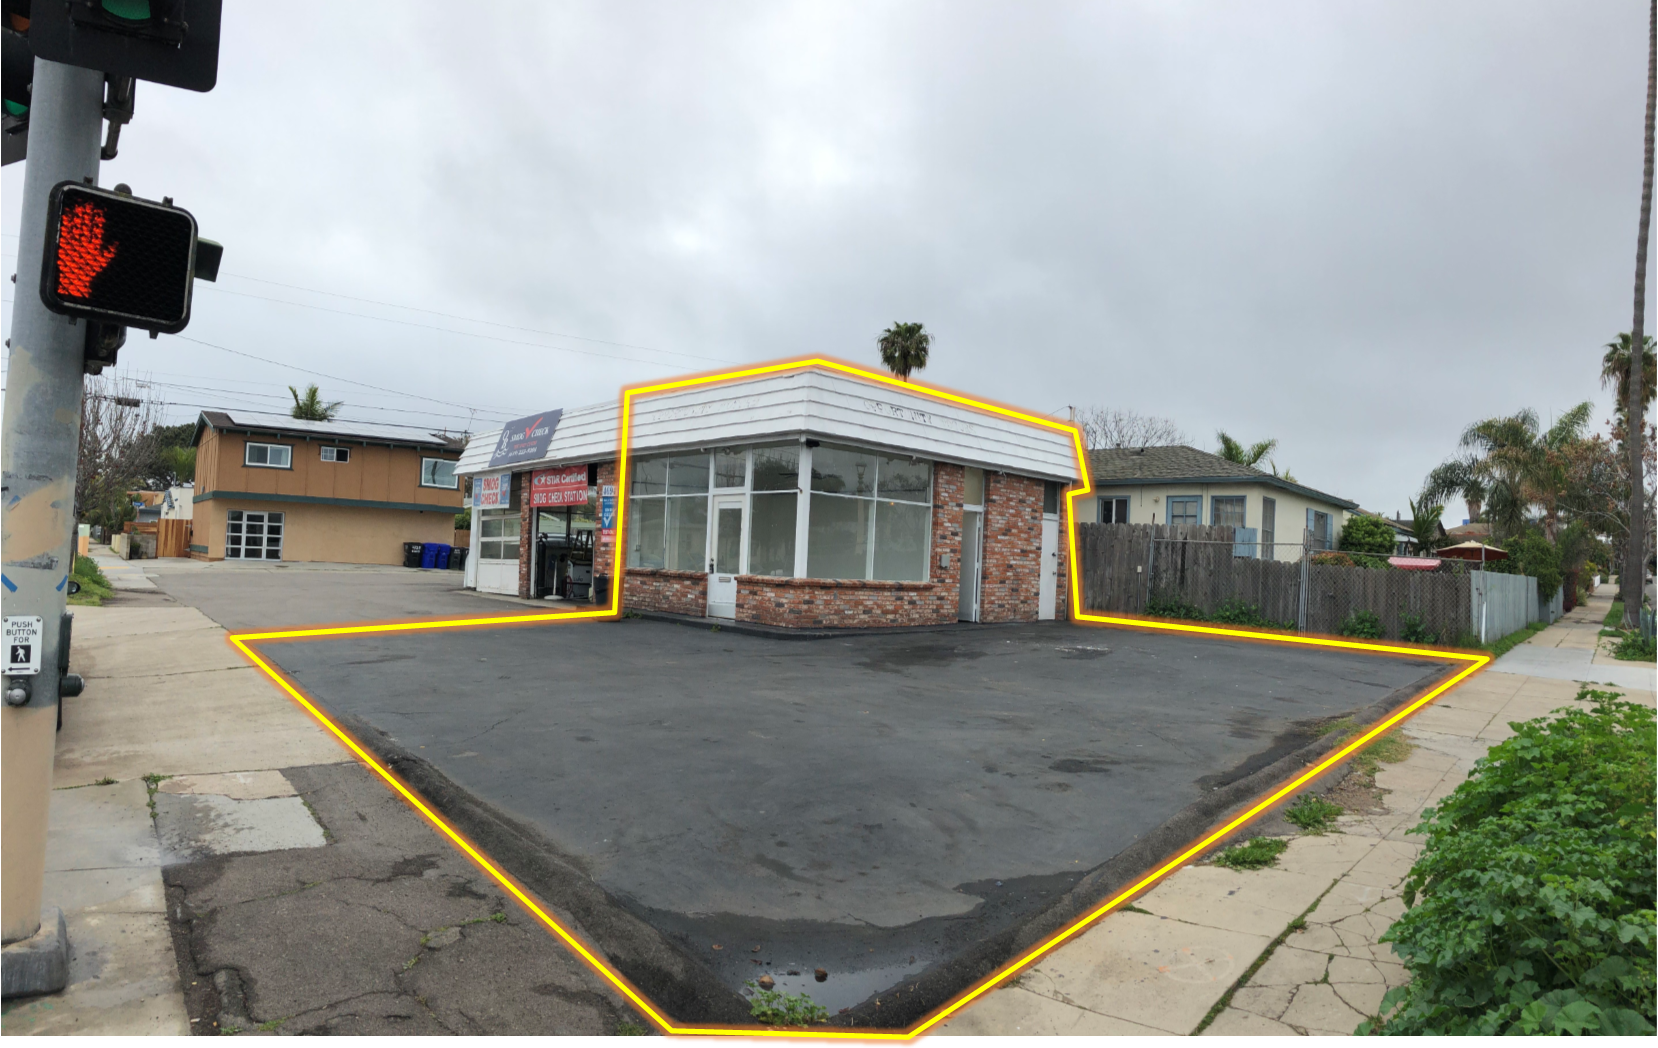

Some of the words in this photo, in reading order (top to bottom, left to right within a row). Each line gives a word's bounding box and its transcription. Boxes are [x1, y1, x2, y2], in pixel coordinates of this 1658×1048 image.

[483, 477, 499, 492] SMOG
[546, 475, 560, 485] STAR
[561, 471, 586, 484] Certified
[480, 491, 500, 506] CHECK
[533, 492, 547, 504] SMOG
[548, 491, 563, 504] CHECK
[564, 489, 588, 503] STATION
[6, 628, 38, 636] BUTTON
